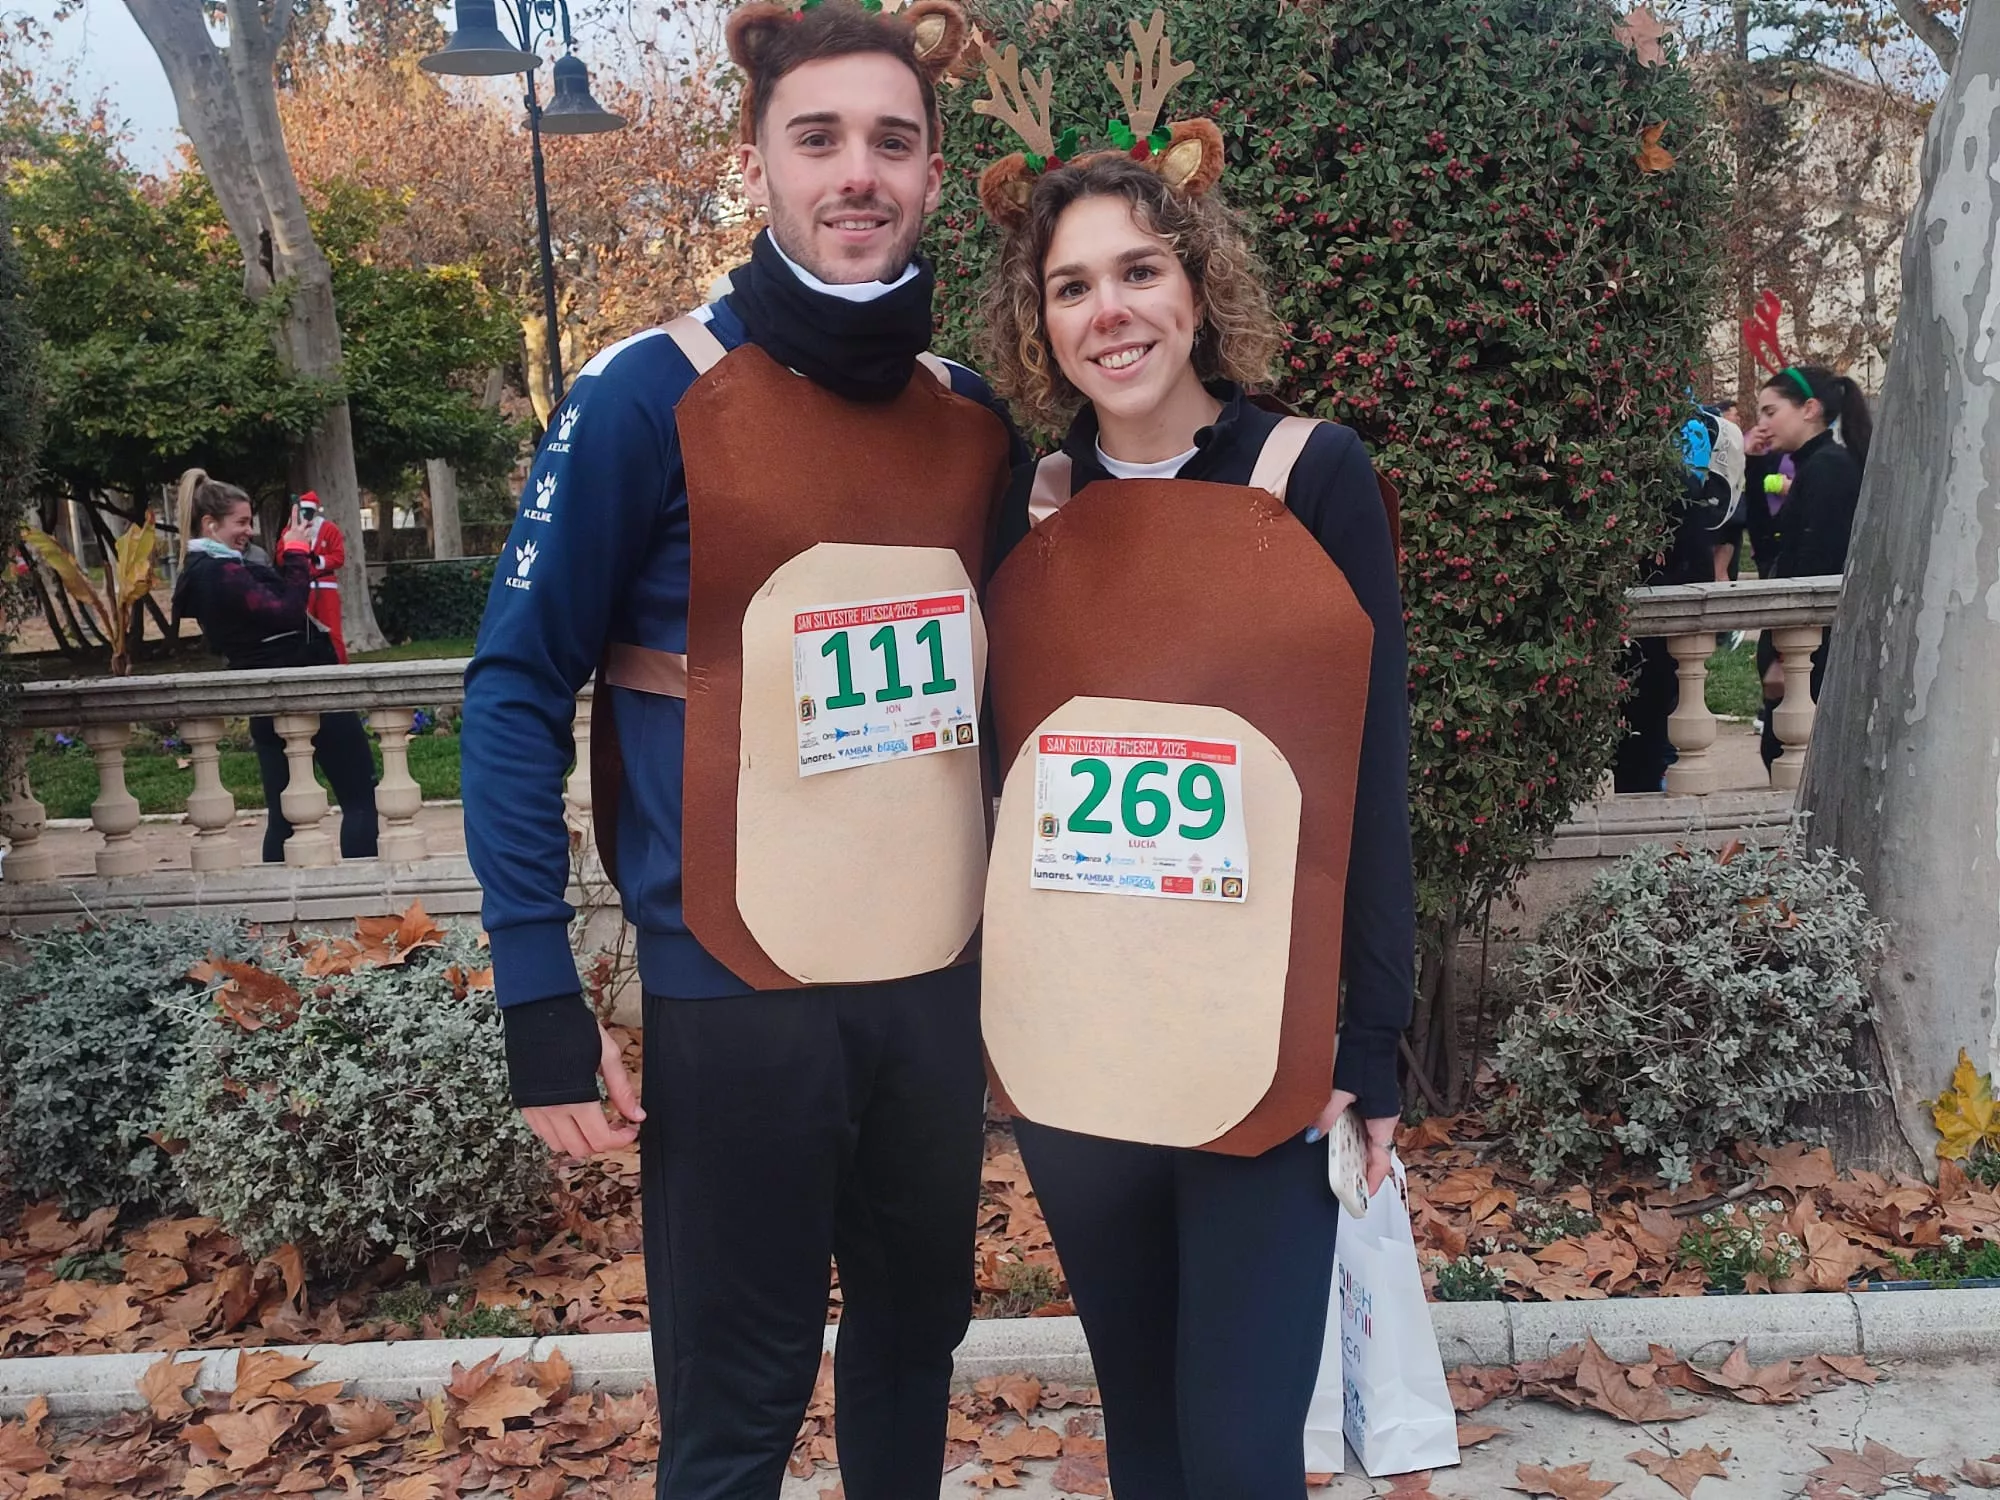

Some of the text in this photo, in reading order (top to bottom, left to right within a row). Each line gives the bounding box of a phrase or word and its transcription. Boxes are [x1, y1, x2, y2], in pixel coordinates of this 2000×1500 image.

[797, 614, 813, 631] SAN
[813, 610, 859, 629] SILVESTRE
[861, 604, 895, 623] HUESCA
[895, 601, 918, 618] 2025
[821, 619, 957, 710] 111
[885, 703, 902, 715] JON
[844, 745, 873, 757] AMBAR
[1047, 737, 1067, 752] SAN
[1069, 739, 1117, 755] SILVESTRE
[1119, 740, 1159, 756] HUESCA
[1161, 742, 1187, 757] 2025
[1067, 758, 1226, 840] 269
[1084, 873, 1115, 883] AMBAR
